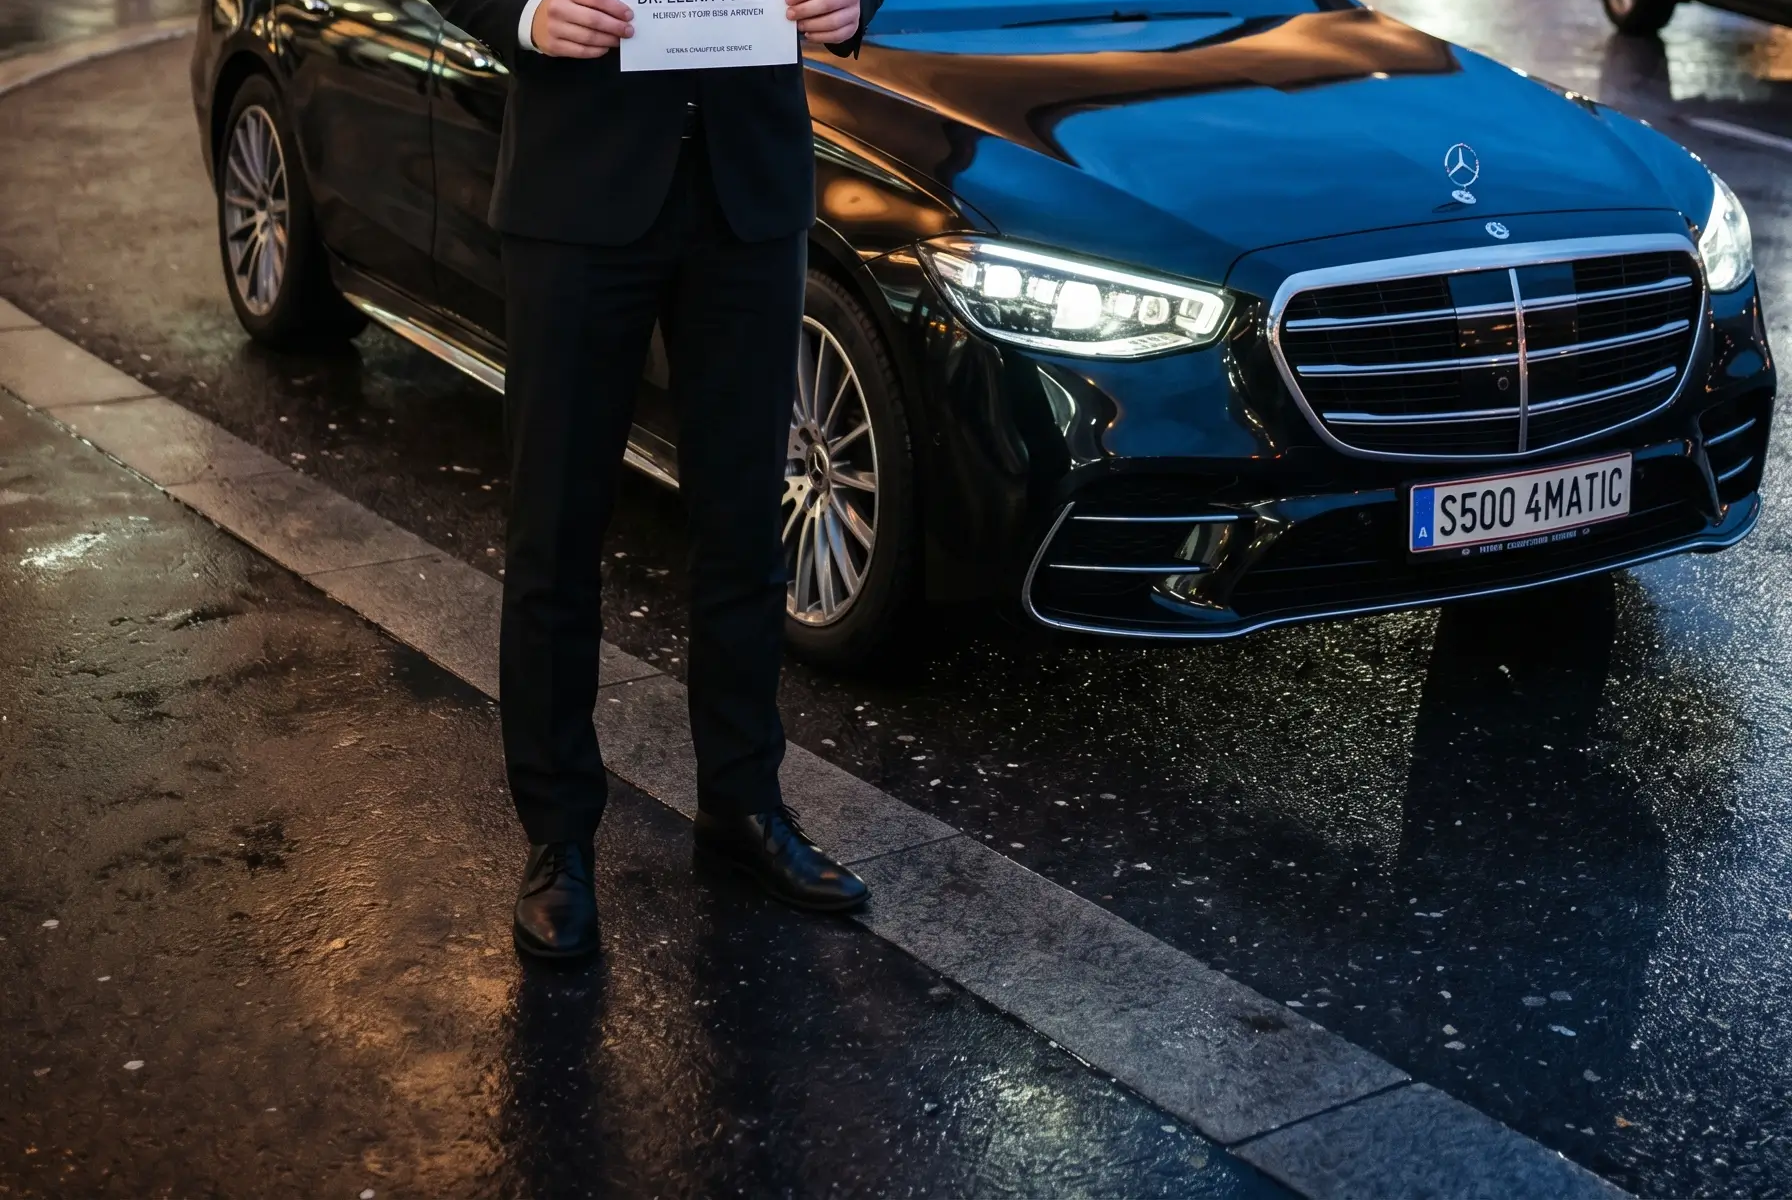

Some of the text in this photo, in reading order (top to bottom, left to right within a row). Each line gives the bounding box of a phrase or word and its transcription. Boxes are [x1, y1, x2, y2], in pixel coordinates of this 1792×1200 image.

[1440, 467, 1623, 537] S500 4MATIC
[1418, 526, 1428, 539] A
